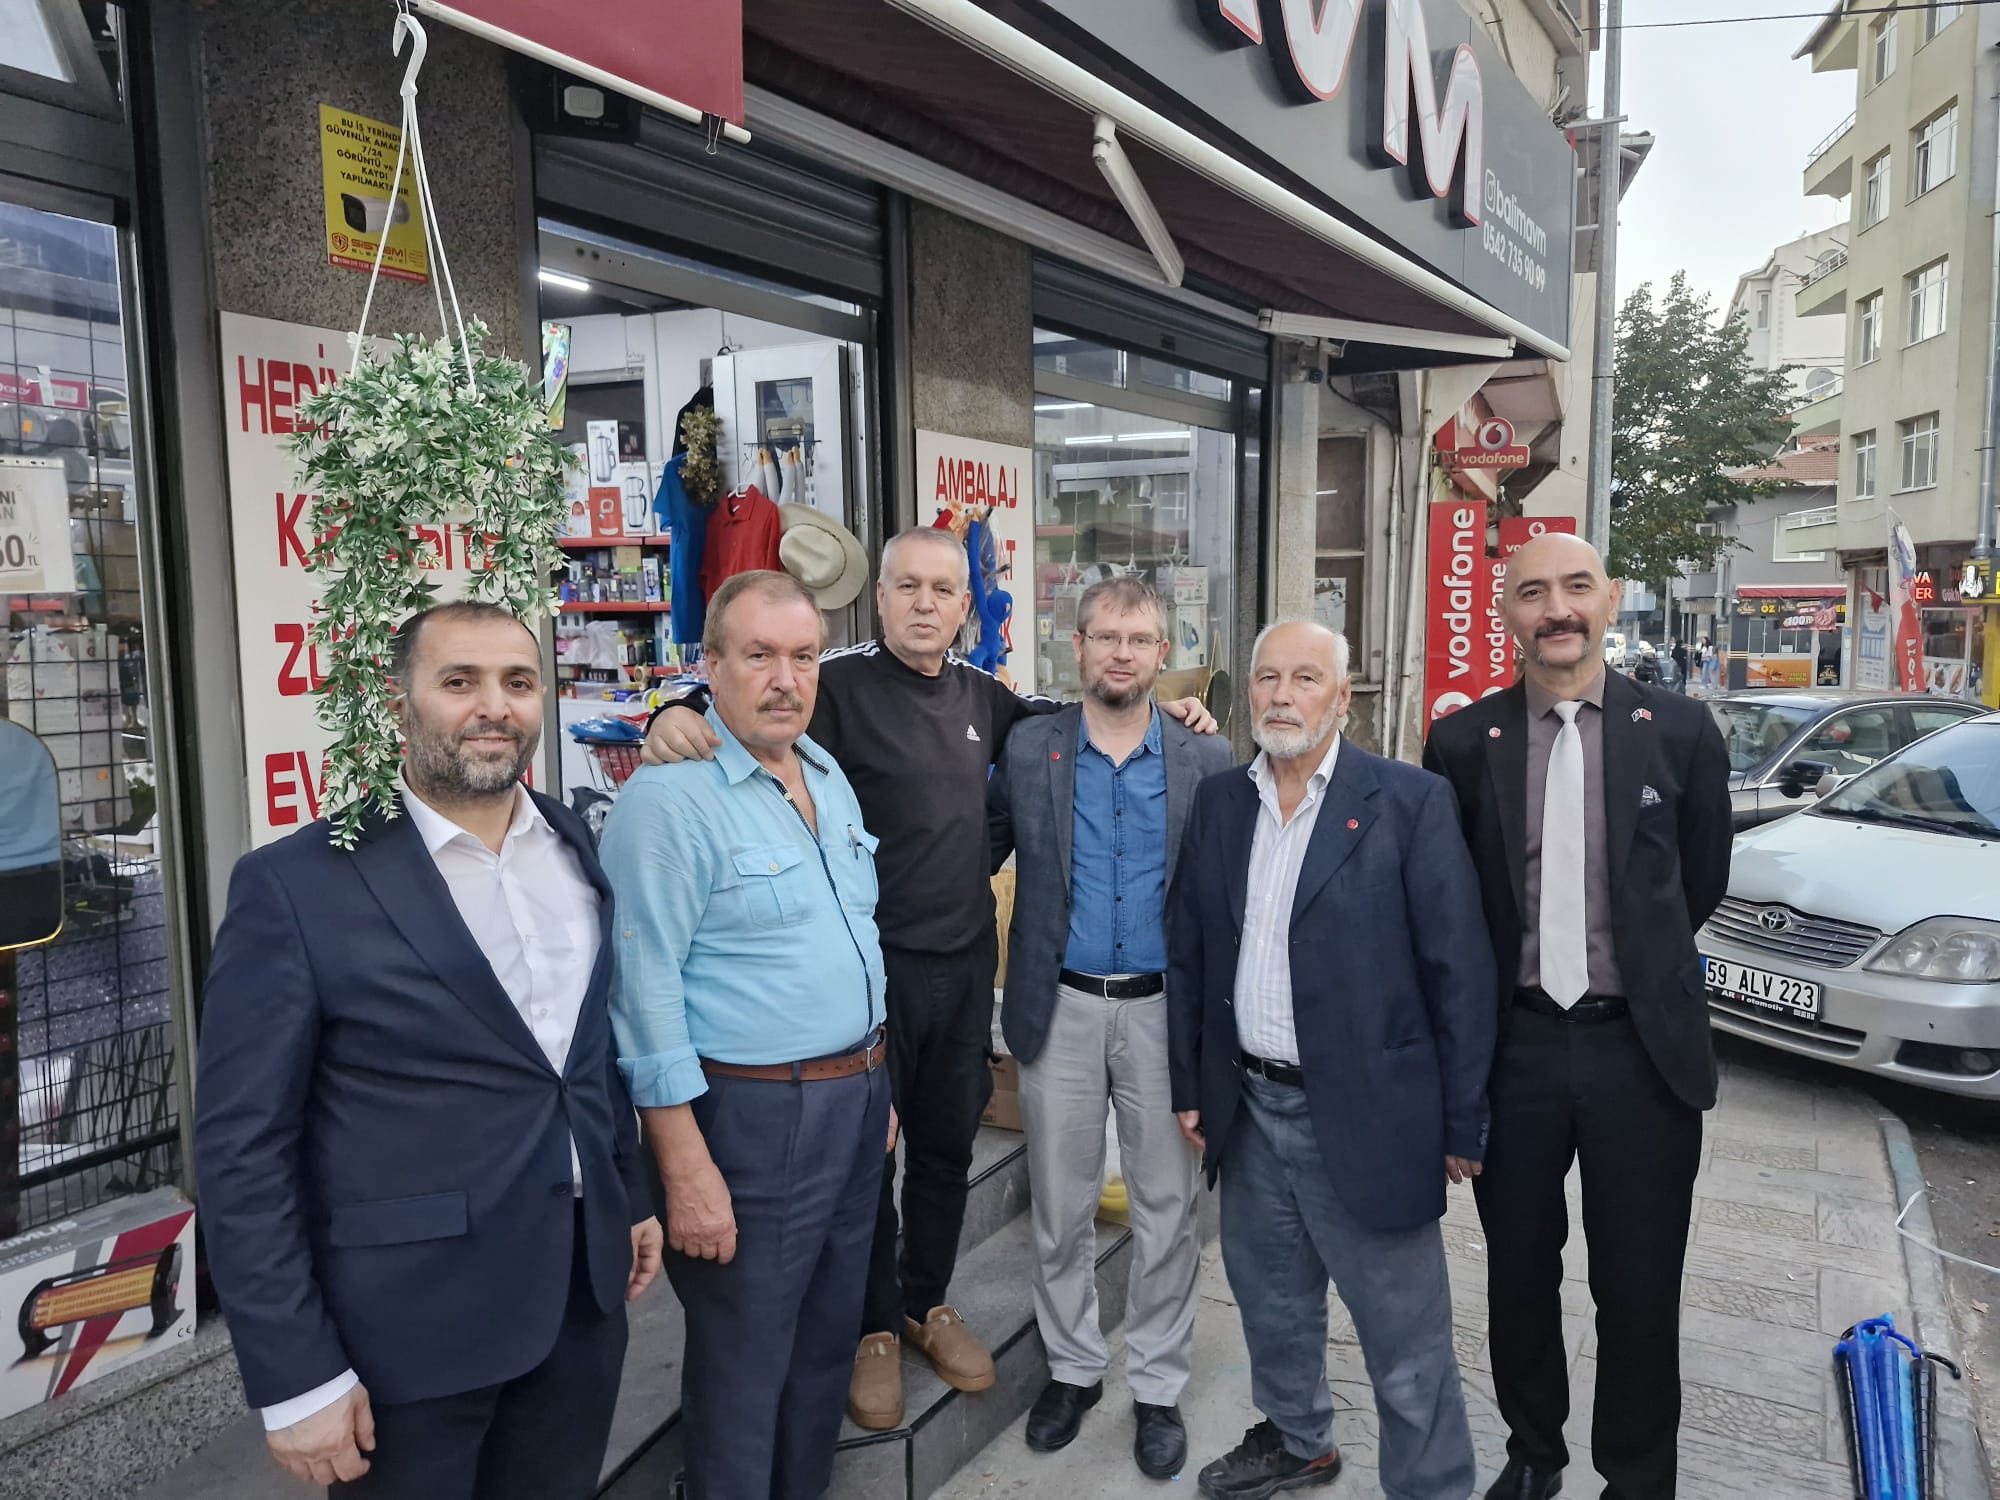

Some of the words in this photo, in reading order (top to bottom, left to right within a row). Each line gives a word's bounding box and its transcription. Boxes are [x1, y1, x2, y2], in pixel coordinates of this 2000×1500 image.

[326, 123, 371, 145] GÜVENLİK
[341, 117, 353, 129] BU
[336, 148, 381, 168] GÖRÜNTÜ
[362, 145, 383, 158] 7/24
[361, 166, 388, 181] KAYDI
[1495, 179, 1546, 257] balimavm
[1483, 220, 1506, 263] 0542
[1507, 239, 1523, 277] 735
[1525, 254, 1535, 286] 90
[1535, 264, 1546, 293] 99
[1460, 452, 1525, 465] vodafone
[935, 455, 1017, 509] AMBALAJ
[1442, 508, 1476, 679] vodafone
[1707, 960, 1727, 986] 59
[1738, 969, 1773, 998] ALV
[1779, 979, 1814, 1009] 223
